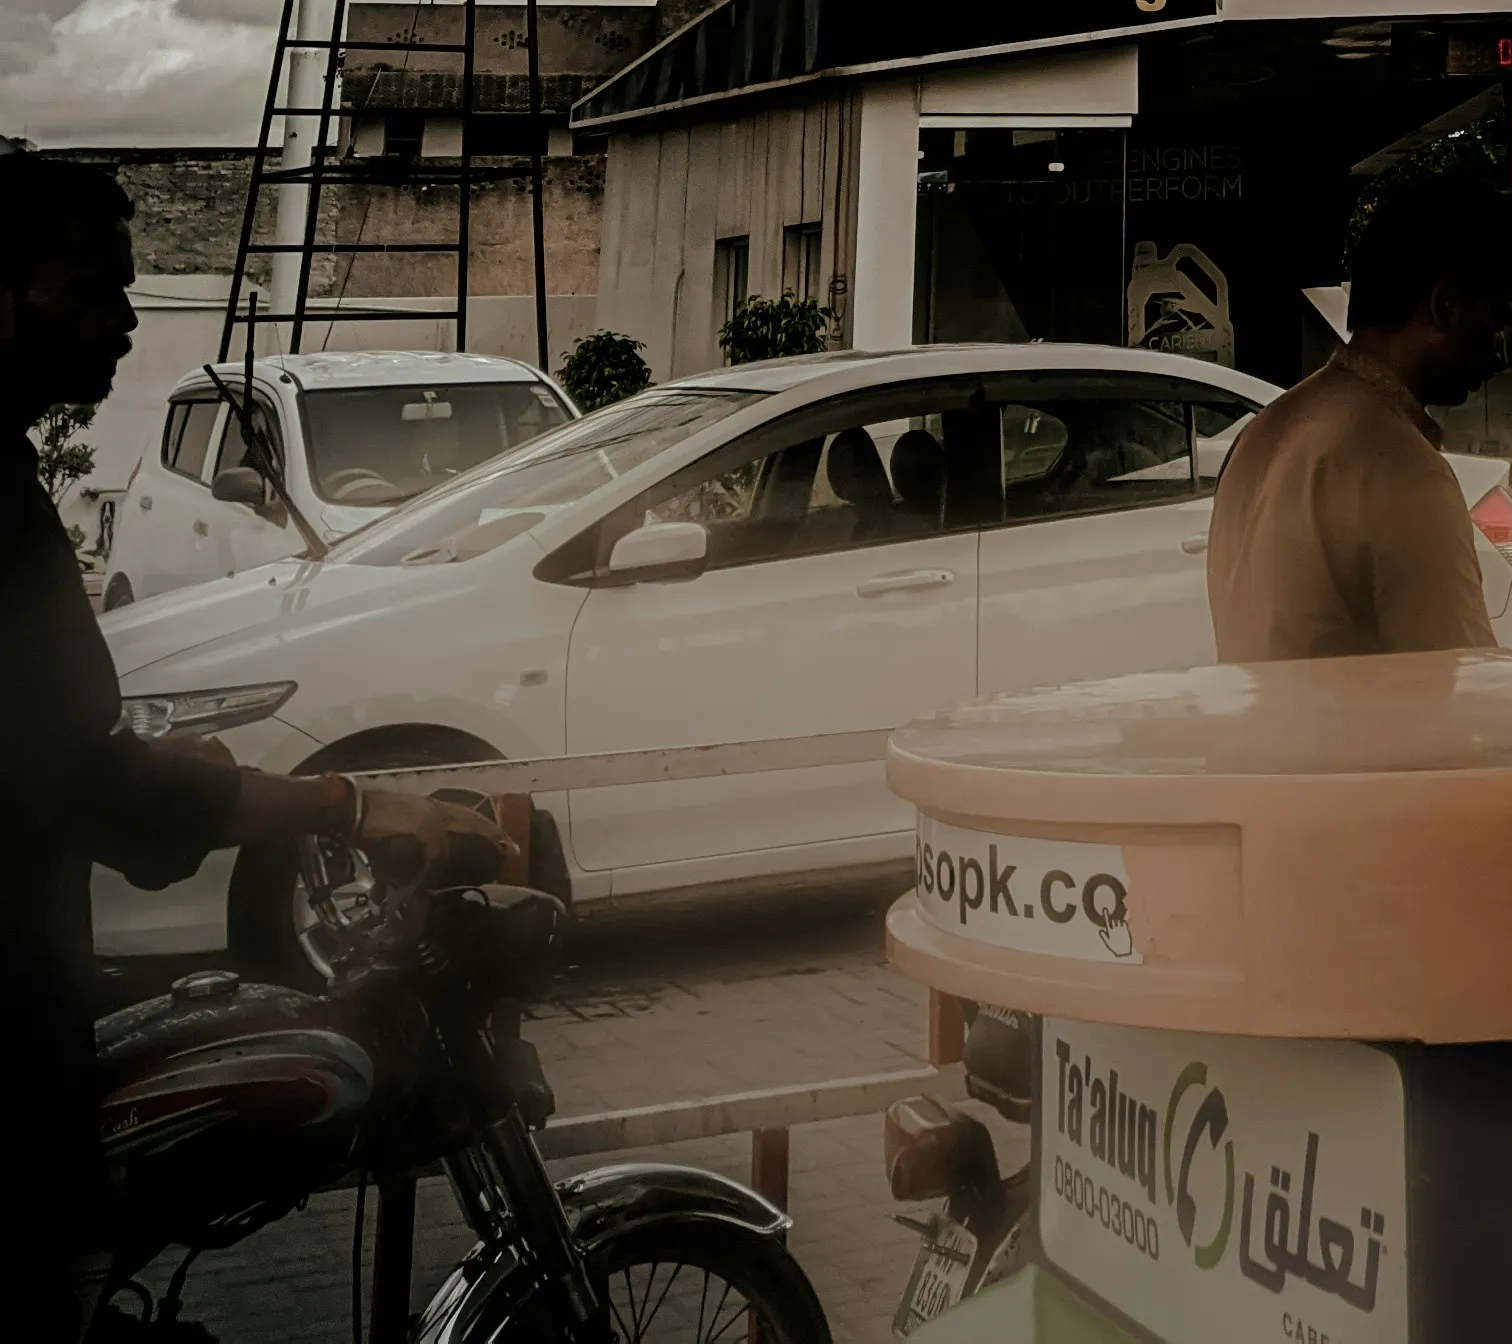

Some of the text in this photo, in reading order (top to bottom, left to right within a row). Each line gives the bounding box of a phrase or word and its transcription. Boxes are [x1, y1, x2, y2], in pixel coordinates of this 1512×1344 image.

[1055, 1037, 1158, 1206] Ta'aluq
[1054, 1154, 1161, 1263] 0800-03000
[1239, 1130, 1386, 1315] تعلق
